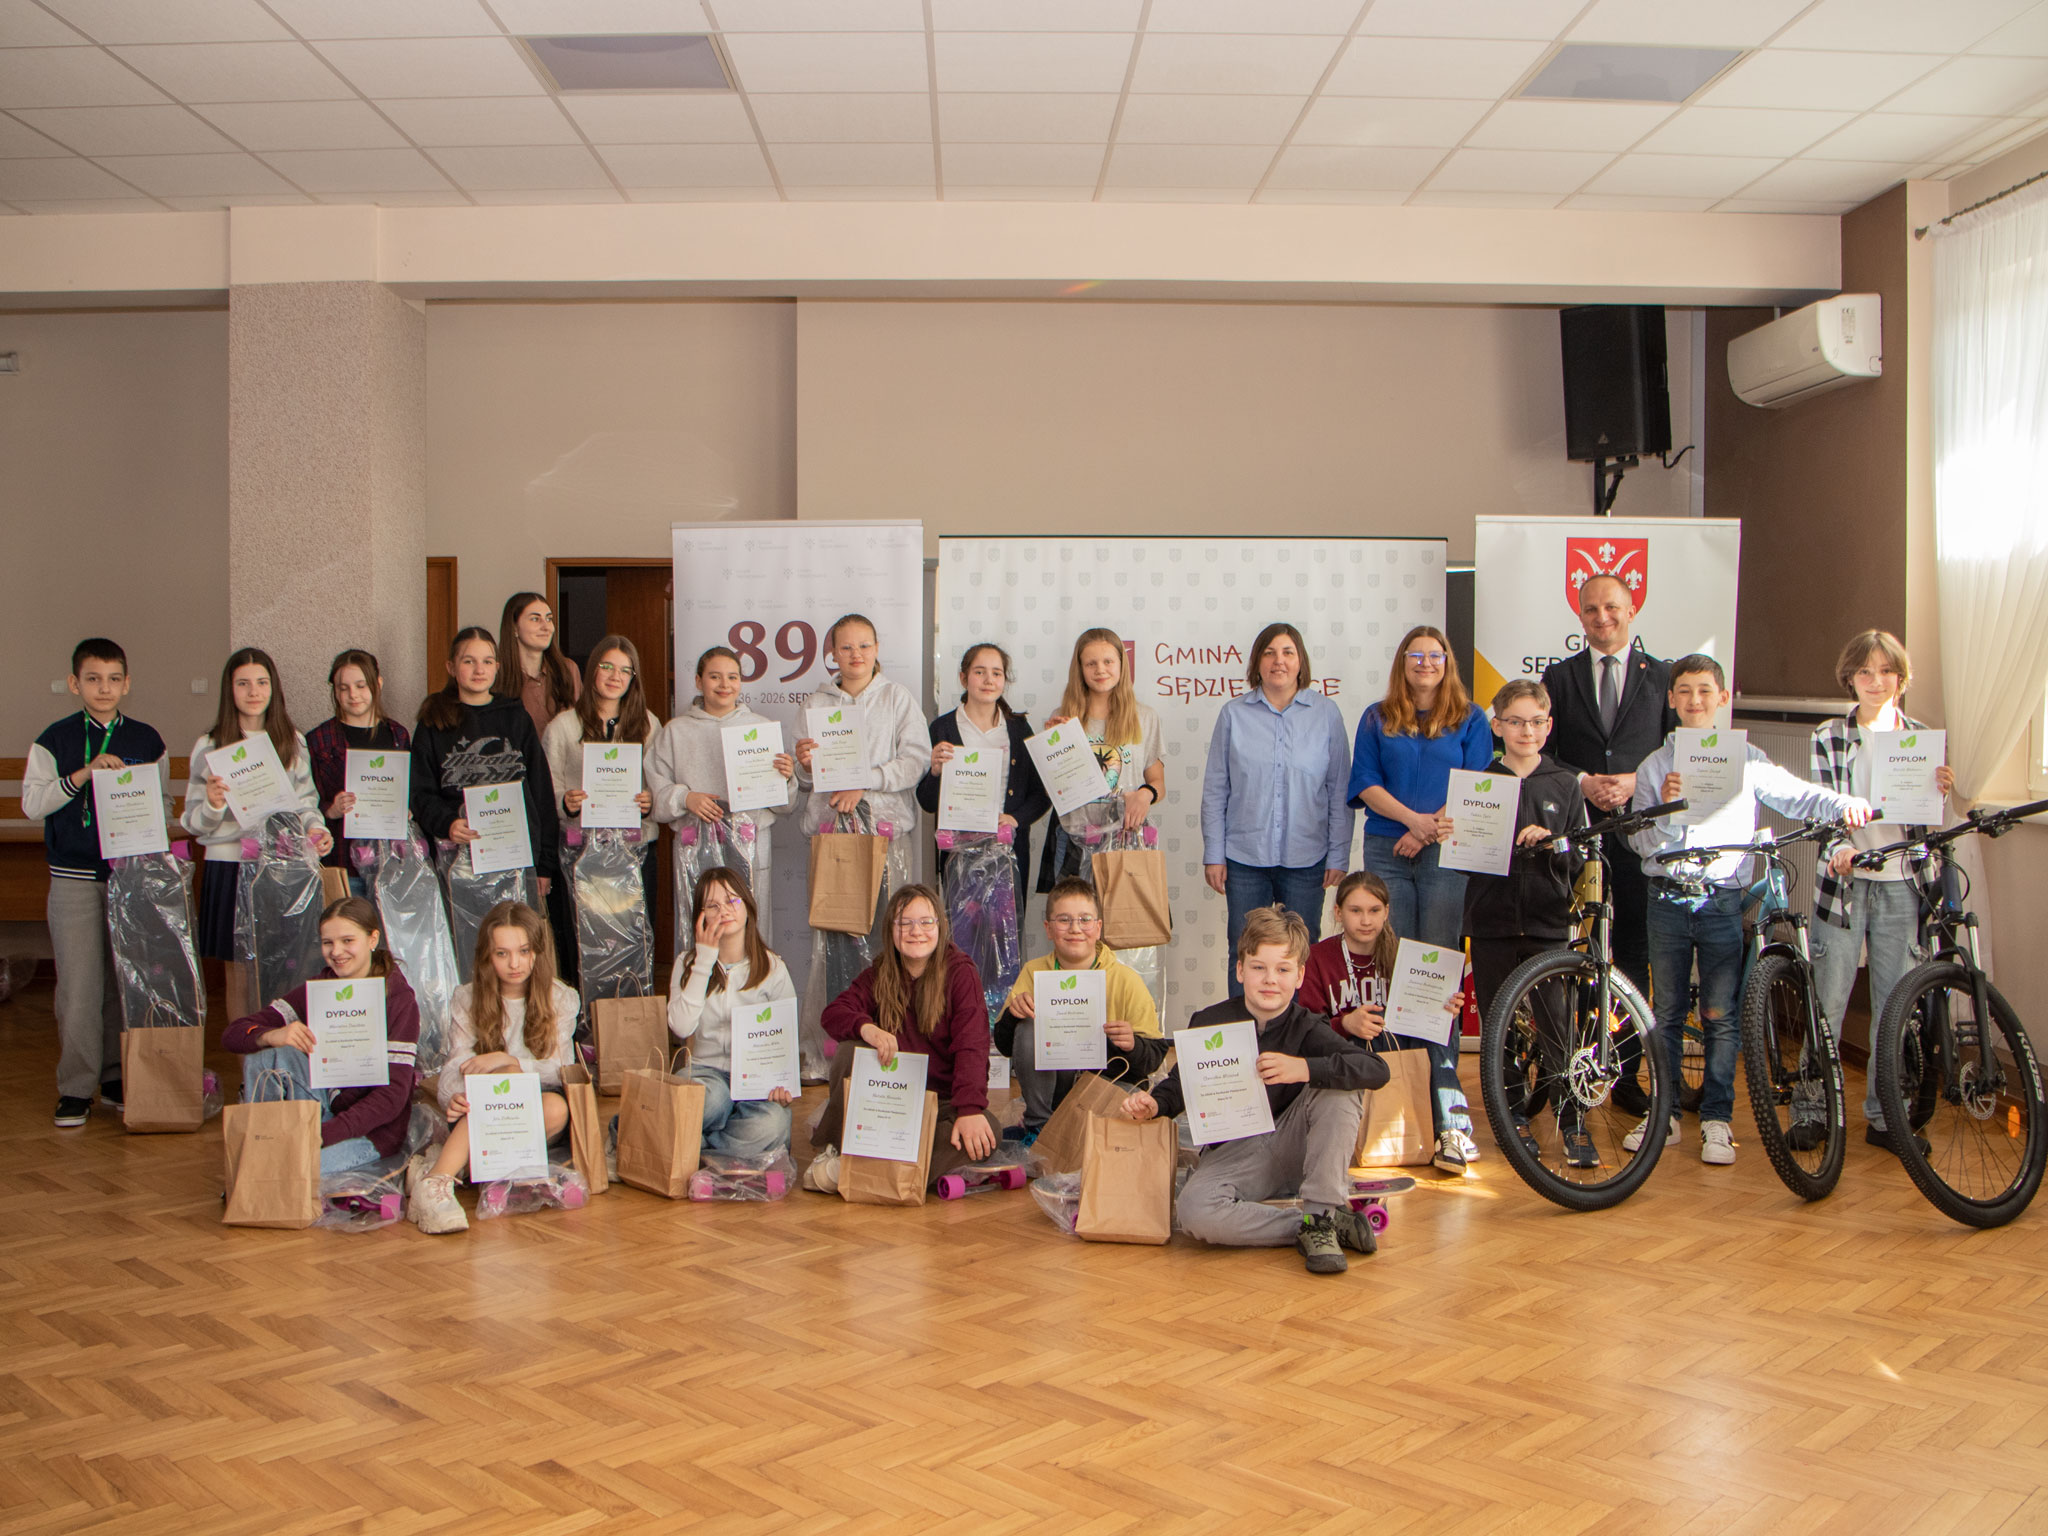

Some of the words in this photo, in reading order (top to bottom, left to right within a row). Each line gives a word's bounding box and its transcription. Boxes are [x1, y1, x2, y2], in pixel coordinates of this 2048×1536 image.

[1155, 642, 1243, 667] GMINA
[760, 693, 786, 704] 2026
[821, 729, 853, 738] DYPLOM
[737, 747, 769, 756] DYPLOM
[1046, 743, 1075, 762] DYPLOM
[1689, 755, 1728, 764] DYPLOM
[230, 761, 265, 779] DYPLOM
[955, 770, 987, 778] DYPLOM
[360, 775, 394, 783] DYPLOM
[110, 790, 146, 800] DYPLOM
[1463, 799, 1501, 810] DYPLOM
[479, 807, 511, 818] DYPLOM
[1409, 967, 1446, 982] DYPLOM
[1050, 998, 1089, 1006] DYPLOM
[325, 1009, 367, 1019] DYPLOM
[747, 1028, 783, 1039] DYPLOM
[1196, 1057, 1240, 1070] DYPLOM
[2016, 1032, 2045, 1104] KROSS
[868, 1079, 908, 1091] DYPLOM
[485, 1102, 524, 1111] DYPLOM
